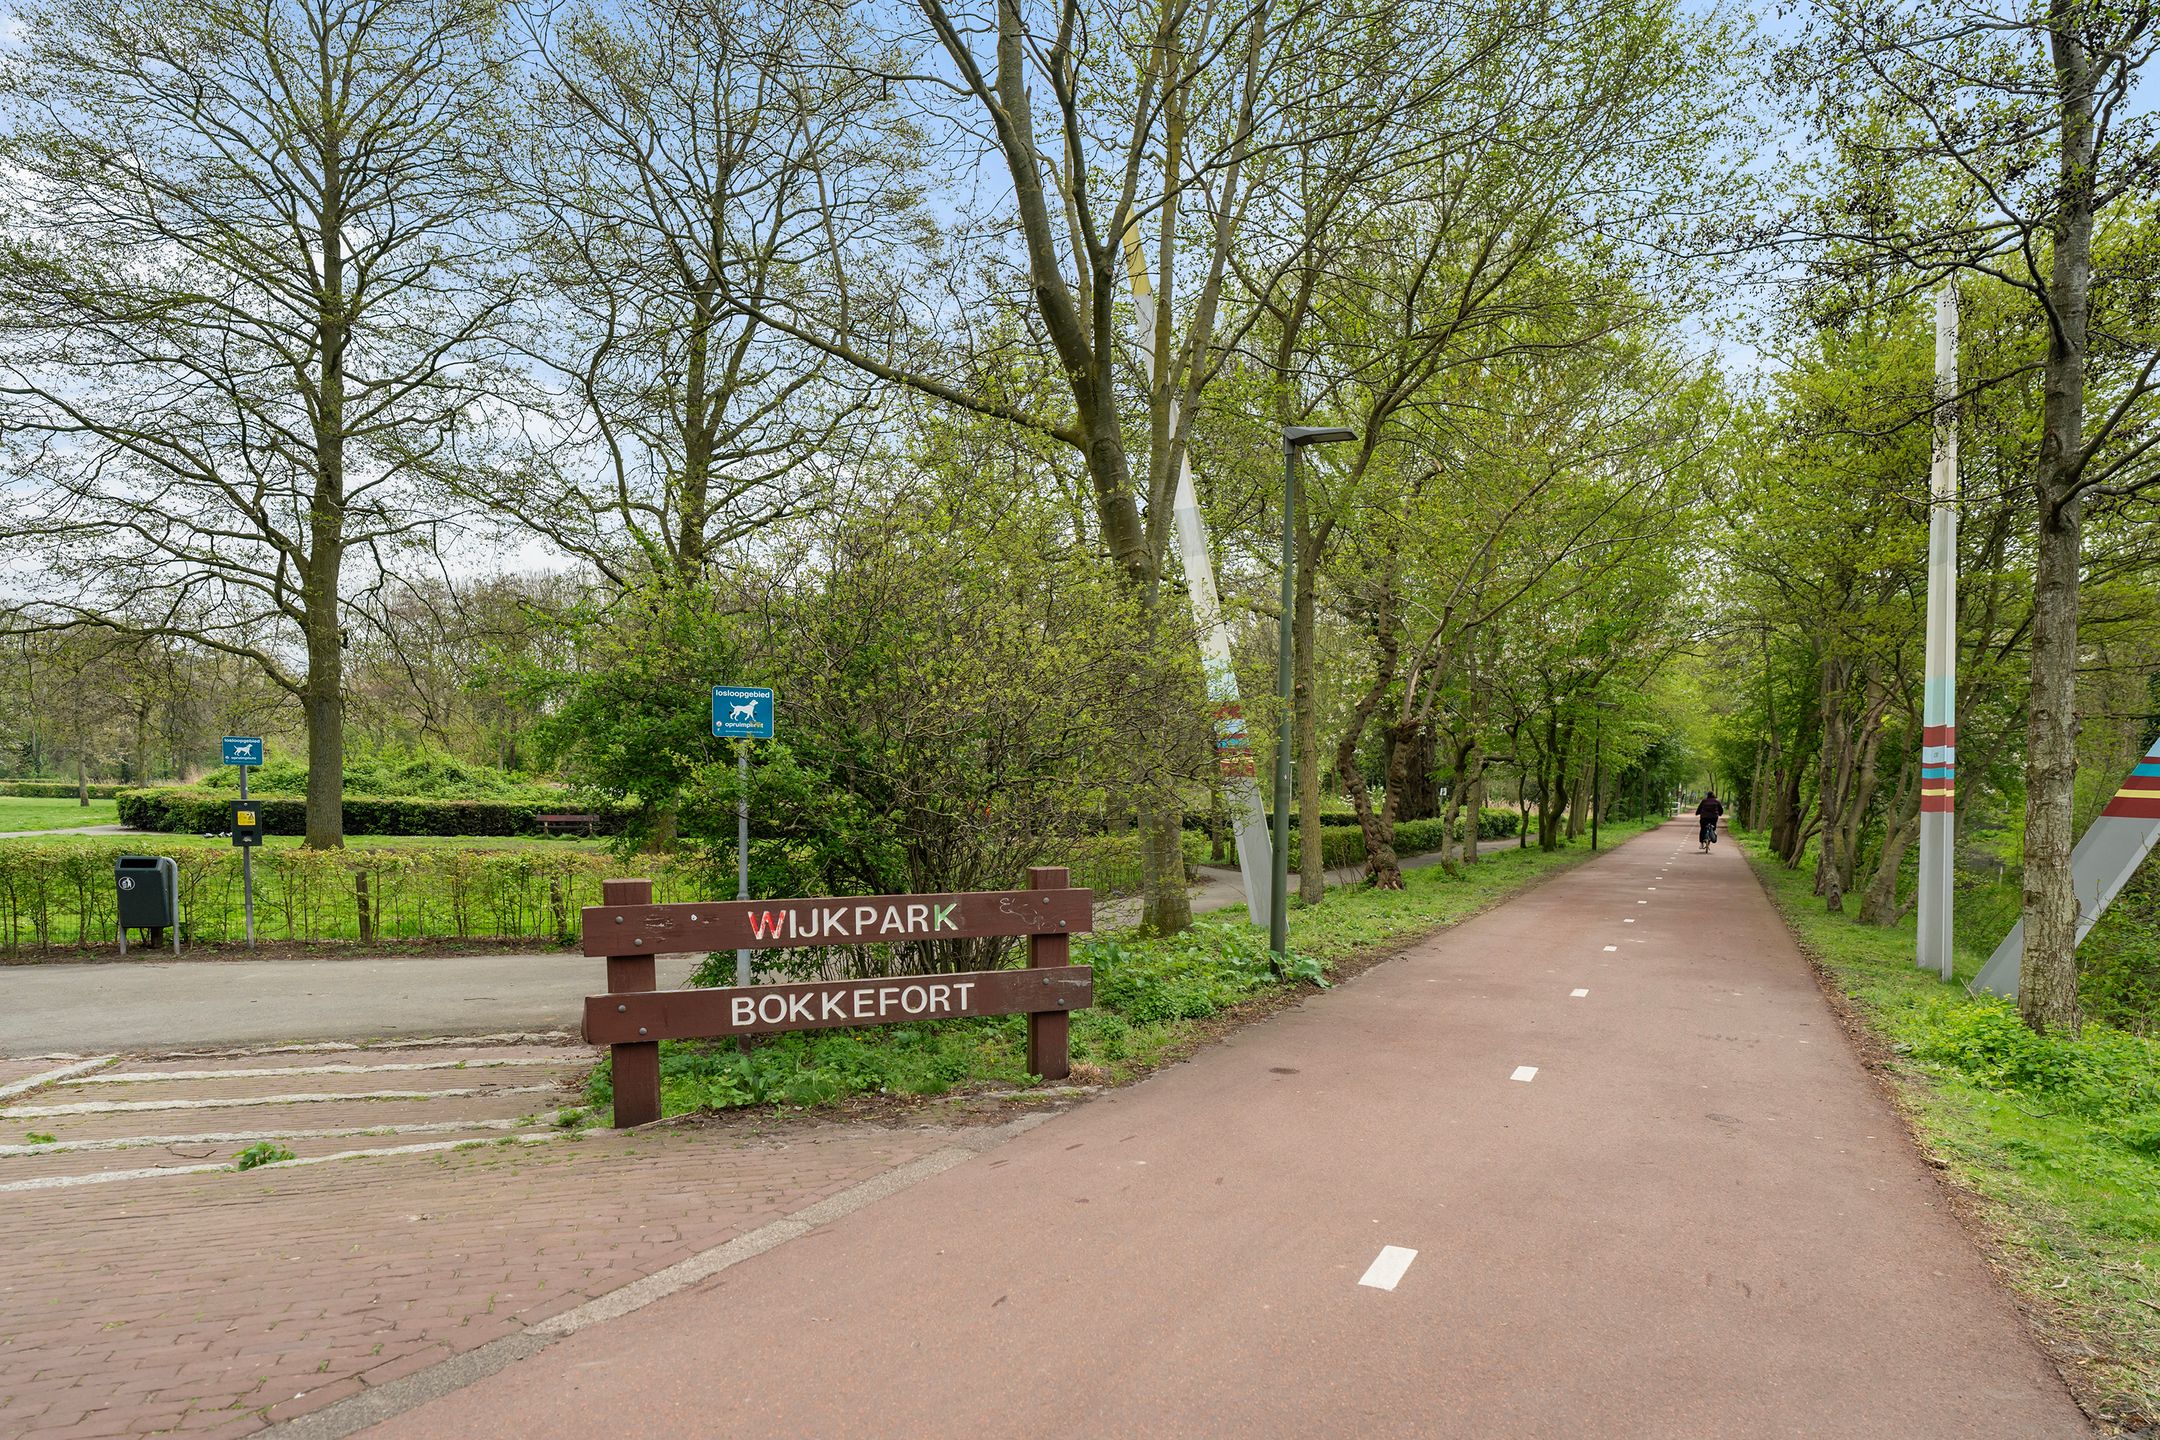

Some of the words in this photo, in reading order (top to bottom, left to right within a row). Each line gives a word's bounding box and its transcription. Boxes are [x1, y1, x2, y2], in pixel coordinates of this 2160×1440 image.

[716, 689, 770, 699] losloopgebied
[747, 903, 959, 940] WIJKPARK
[731, 982, 975, 1026] BOKKEFORT
